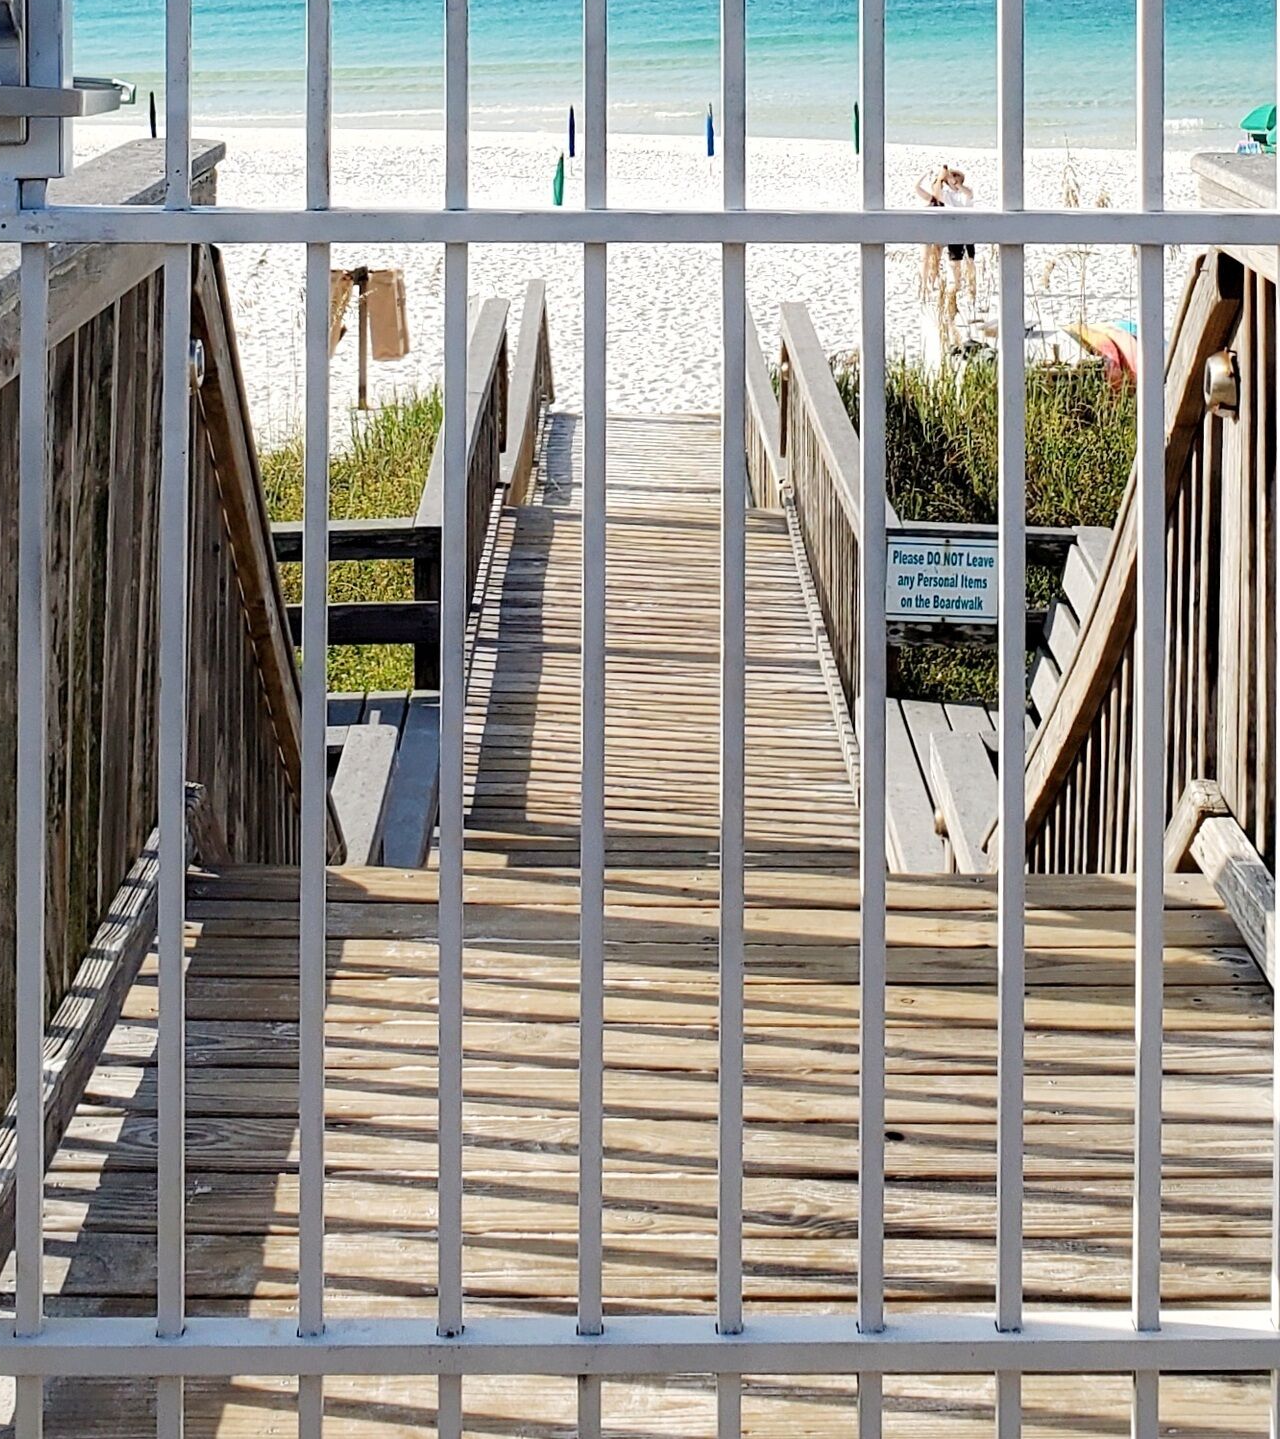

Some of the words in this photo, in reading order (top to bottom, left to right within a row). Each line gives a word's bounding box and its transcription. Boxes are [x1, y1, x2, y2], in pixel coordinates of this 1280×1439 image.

[893, 550, 924, 565] Please
[927, 551, 940, 565] DO
[943, 552, 964, 566] NOT
[967, 553, 994, 567] Leave
[898, 575, 915, 590] any
[917, 573, 958, 588] Personal
[961, 574, 987, 589] Items
[901, 597, 912, 608] on
[915, 595, 930, 608] the
[933, 595, 983, 610] Boardwalk
